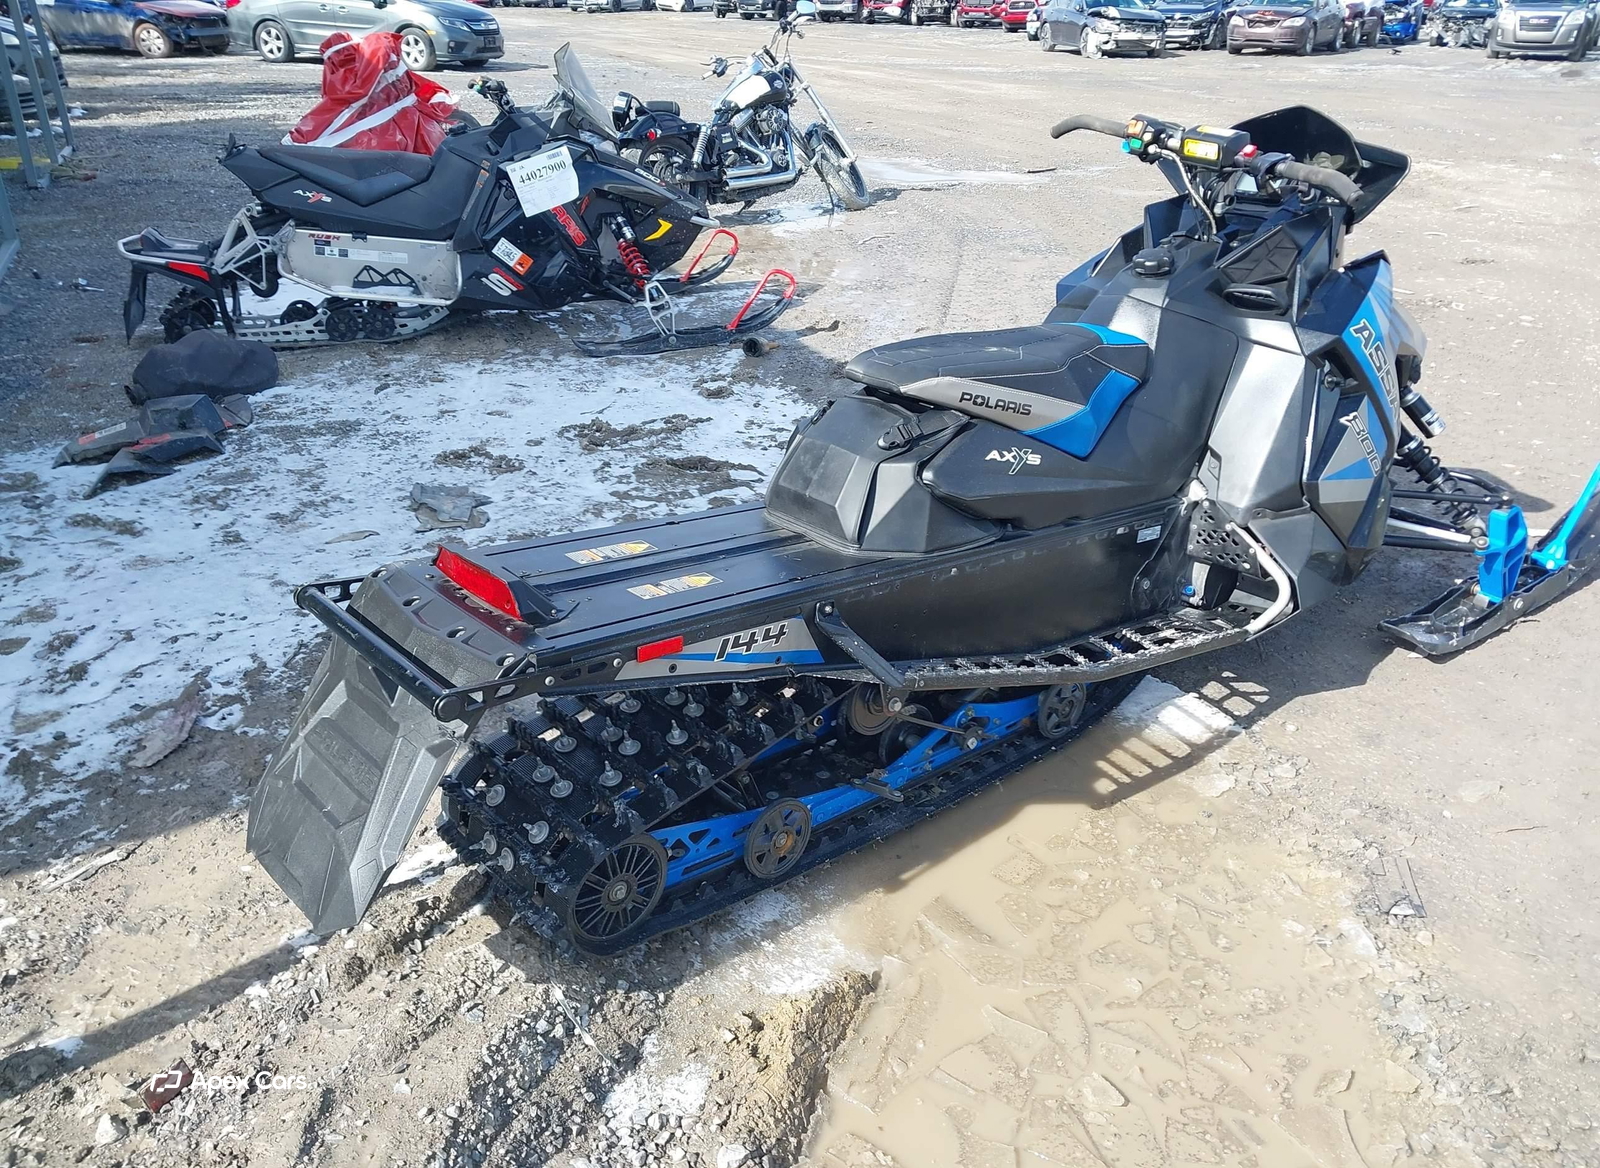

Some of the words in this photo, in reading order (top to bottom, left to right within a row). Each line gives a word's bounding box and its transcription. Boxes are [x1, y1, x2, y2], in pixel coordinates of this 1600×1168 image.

[518, 159, 567, 185] 44027900
[550, 204, 587, 247] ARIS
[958, 391, 1033, 416] POLARIS
[984, 446, 1042, 475] AXYS
[1338, 411, 1382, 477] 800
[713, 621, 790, 663] 144
